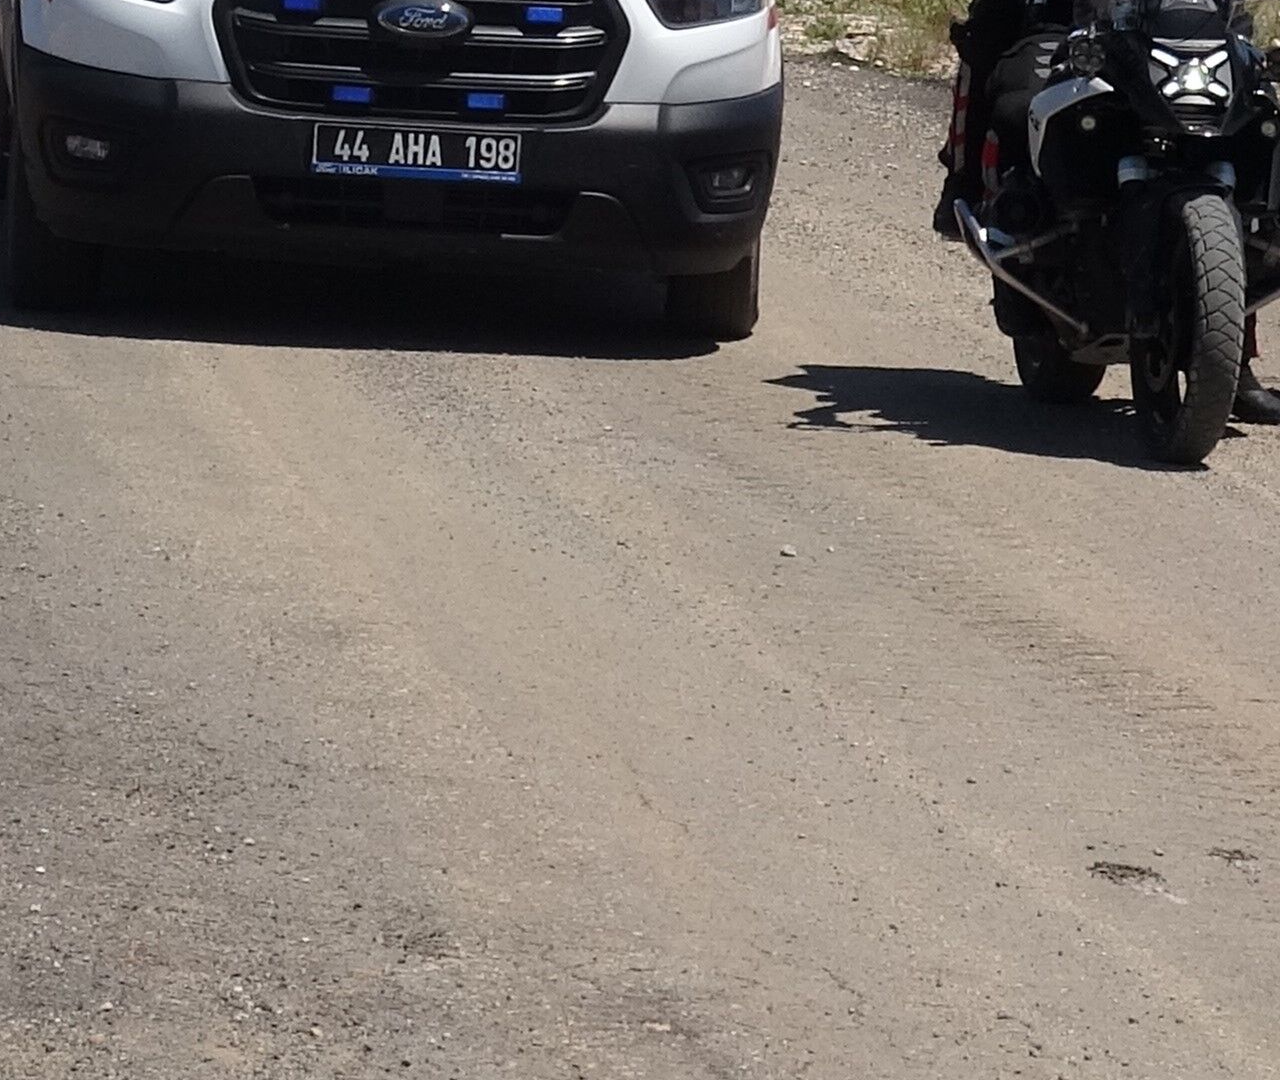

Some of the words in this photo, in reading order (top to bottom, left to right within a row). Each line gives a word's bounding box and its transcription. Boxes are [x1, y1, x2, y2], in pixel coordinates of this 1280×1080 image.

[399, 6, 448, 29] Ford
[334, 129, 369, 161] 44
[388, 132, 442, 166] AHA
[465, 136, 516, 169] 198
